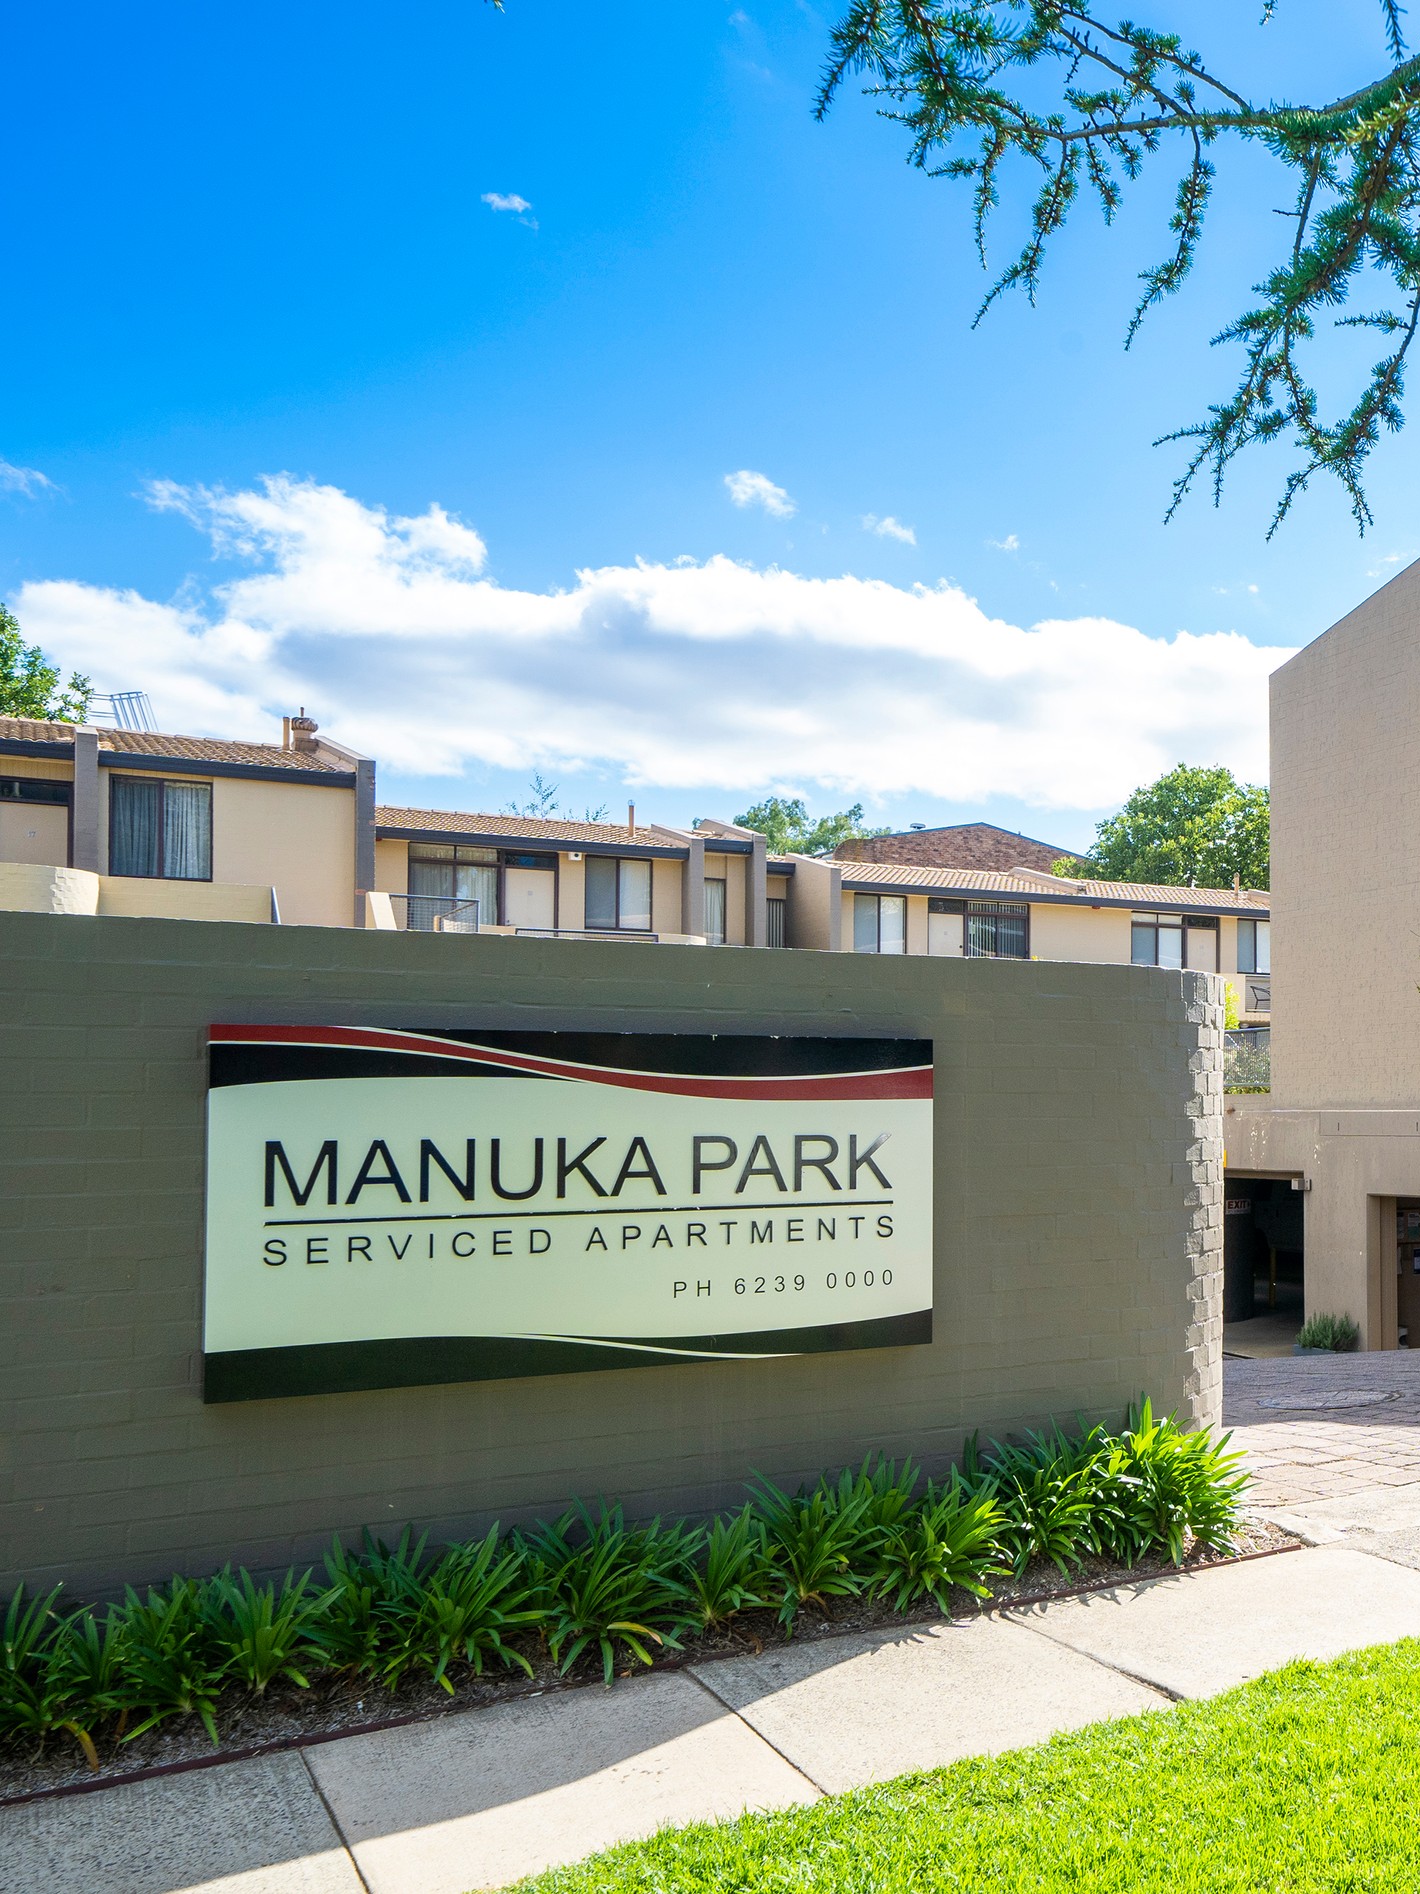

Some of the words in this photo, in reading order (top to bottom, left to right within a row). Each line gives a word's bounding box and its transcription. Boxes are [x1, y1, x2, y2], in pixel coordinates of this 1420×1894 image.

[263, 1137, 667, 1207] MANUKA
[691, 1132, 893, 1195] PARK
[263, 1228, 553, 1266] SERVICED
[586, 1215, 895, 1252] APARTMENTS
[673, 1279, 712, 1299] PH
[733, 1275, 806, 1295] 6239
[825, 1268, 894, 1290] 0000
